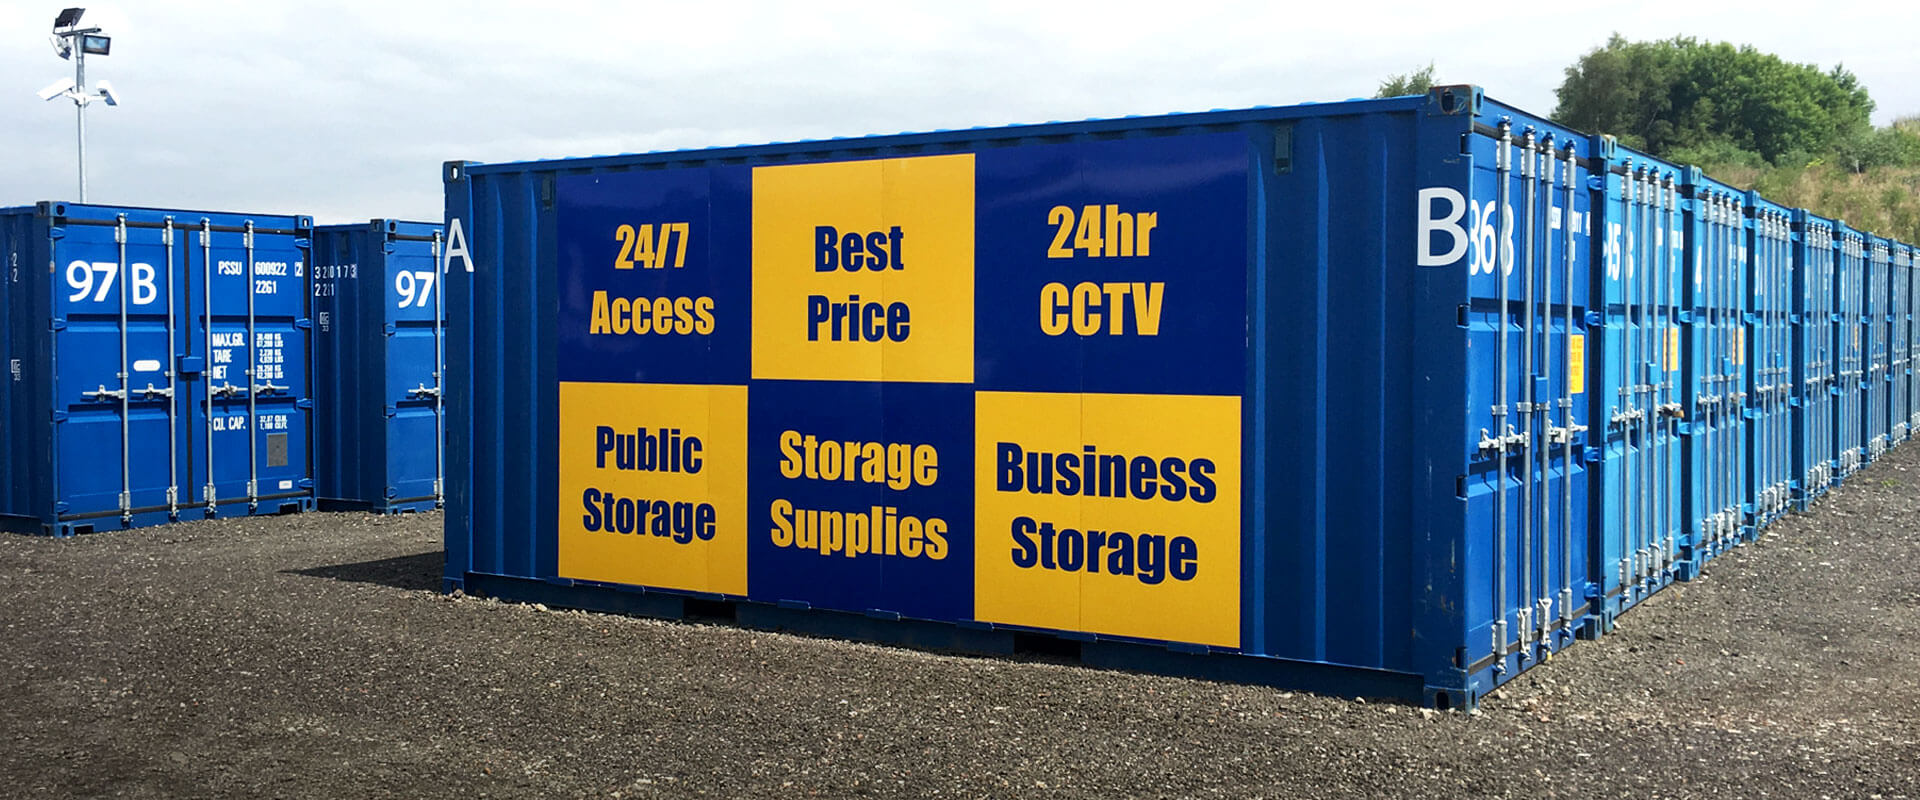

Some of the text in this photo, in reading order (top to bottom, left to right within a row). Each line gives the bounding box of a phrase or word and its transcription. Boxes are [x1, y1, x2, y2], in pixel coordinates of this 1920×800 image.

[444, 218, 475, 274] A
[614, 222, 690, 270] 24/7
[814, 225, 905, 273] Best
[1047, 204, 1158, 259] 24hr
[1417, 187, 1469, 267] B
[65, 259, 158, 305] 97 B
[218, 261, 243, 276] PSSU
[254, 261, 287, 277] 600922
[395, 269, 435, 309] 97
[589, 290, 715, 335] Access
[807, 294, 911, 343] Price
[1039, 281, 1165, 336] CCTV
[212, 365, 227, 379] NET
[213, 349, 232, 363] TARE
[596, 425, 703, 475] Public
[779, 430, 938, 491] Storage
[996, 441, 1217, 504] Business
[582, 487, 716, 545] Storage
[770, 498, 949, 560] Supplies
[1011, 516, 1198, 585] Storage
